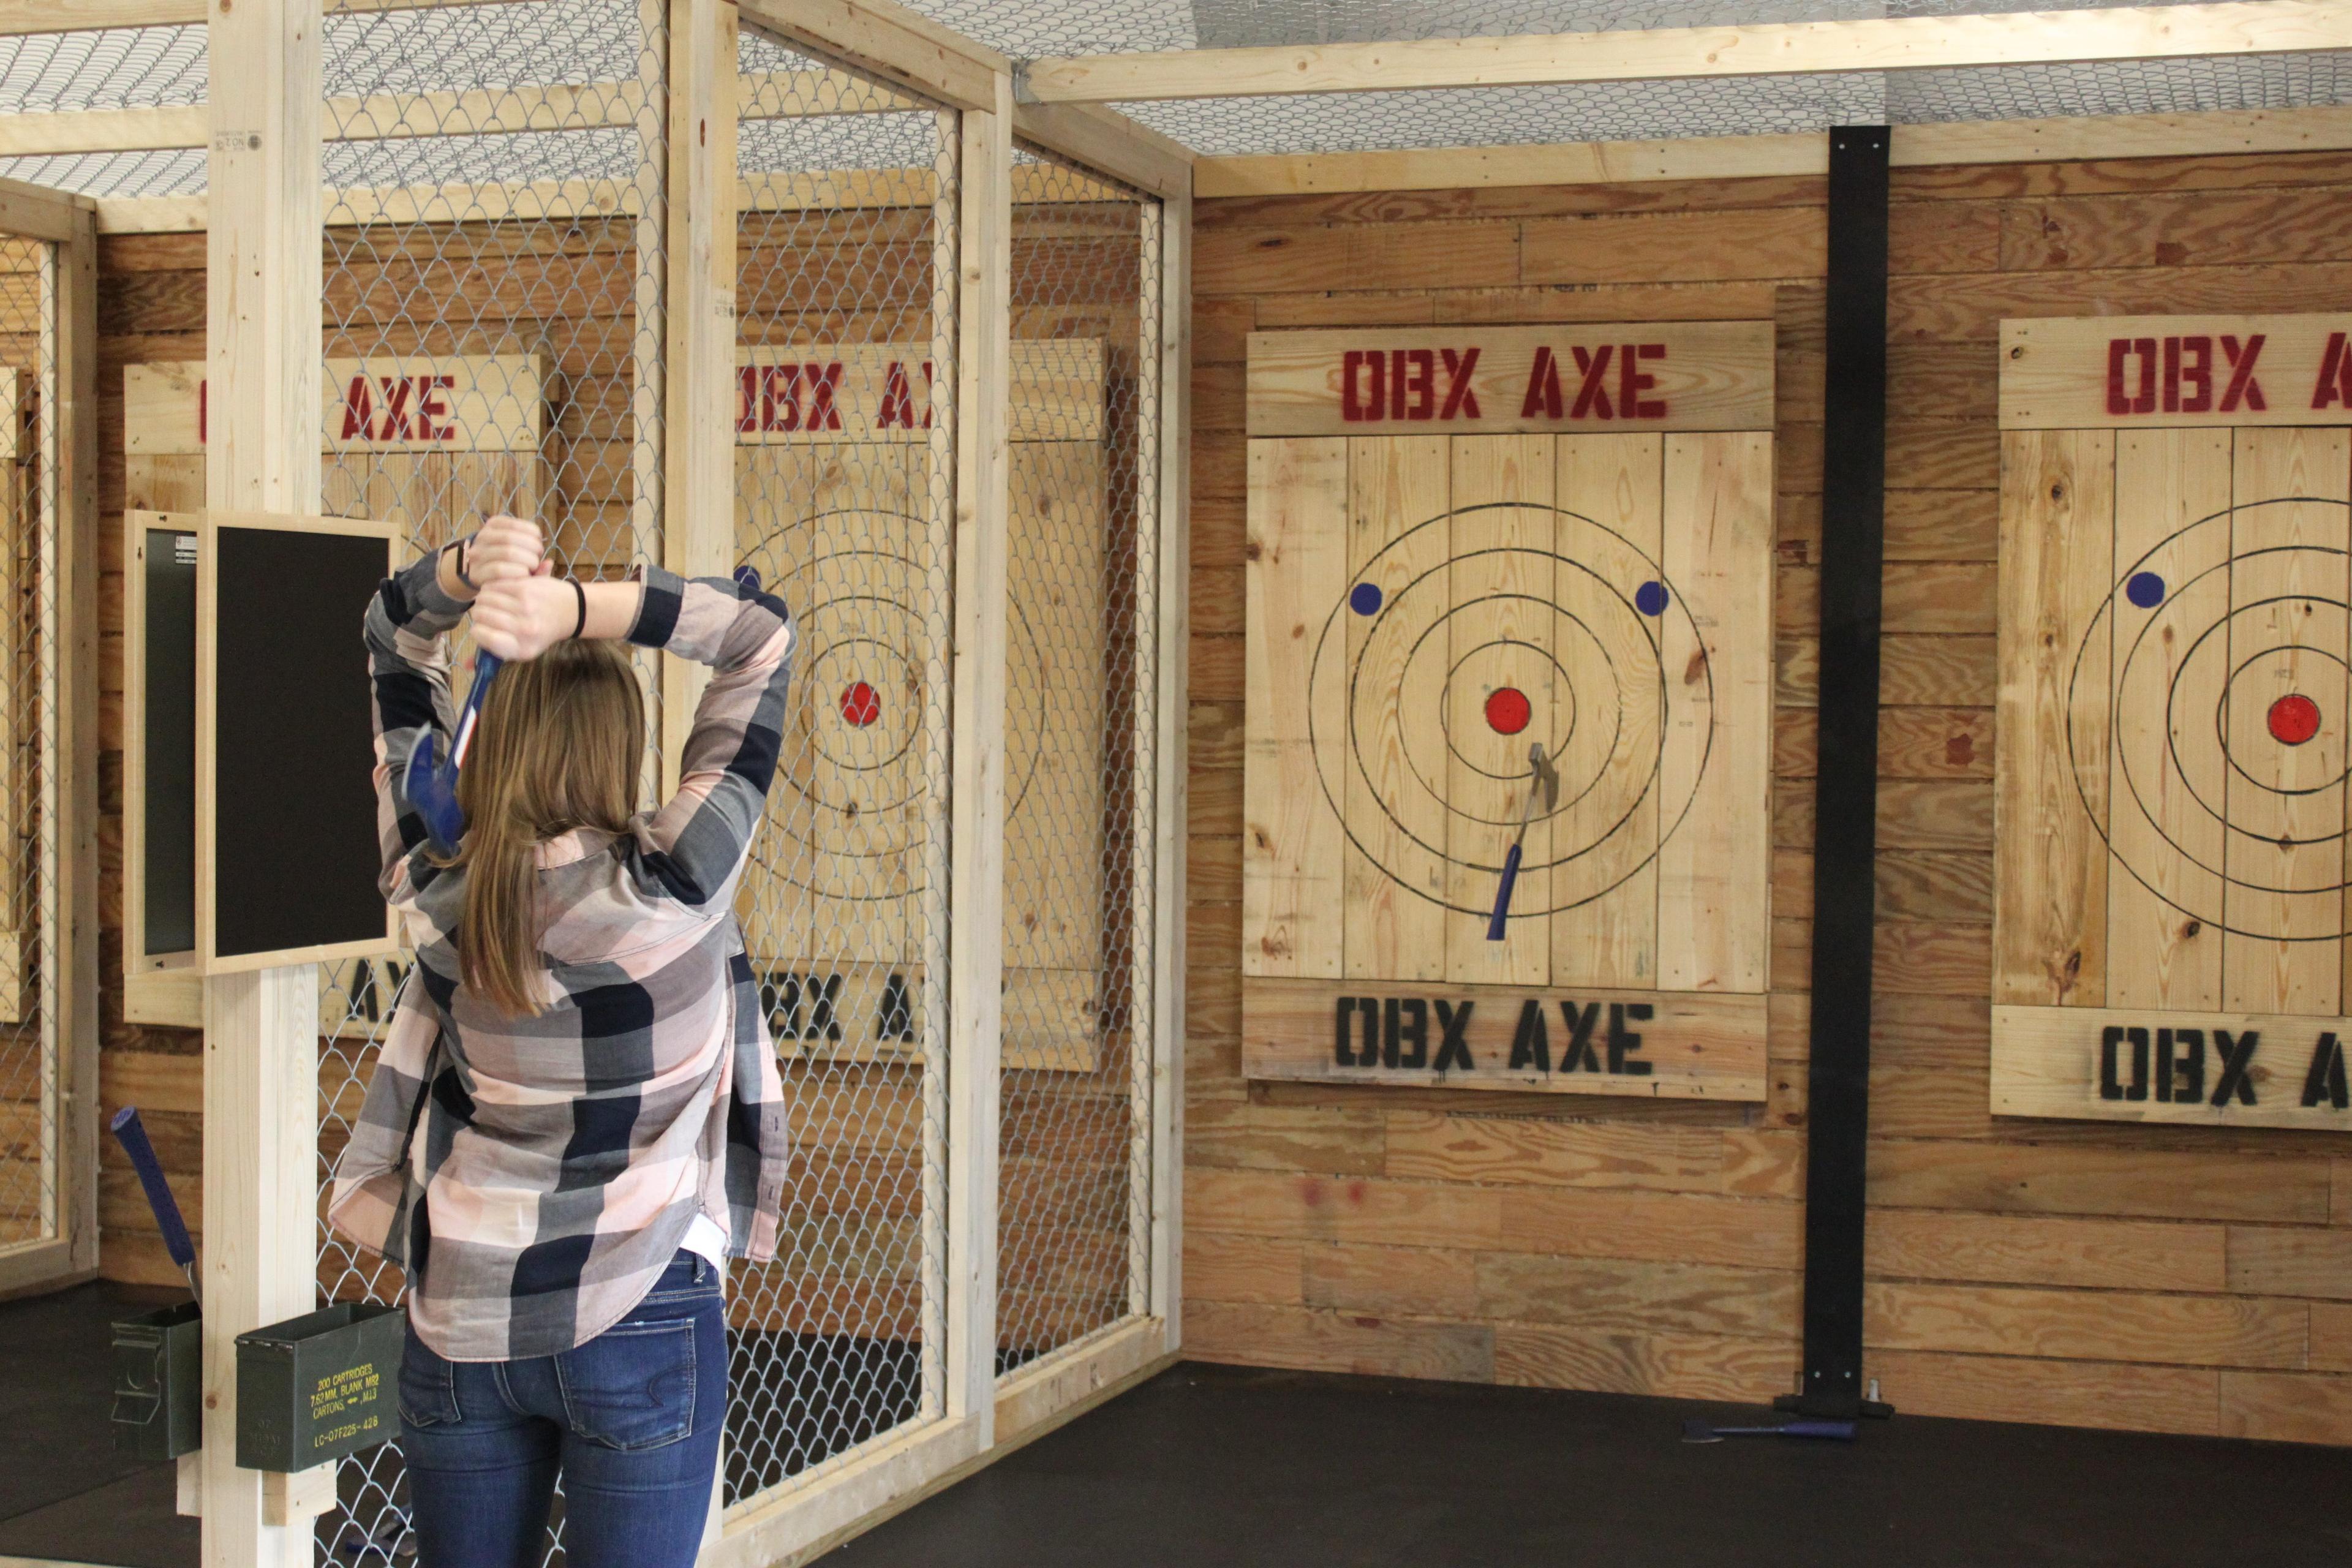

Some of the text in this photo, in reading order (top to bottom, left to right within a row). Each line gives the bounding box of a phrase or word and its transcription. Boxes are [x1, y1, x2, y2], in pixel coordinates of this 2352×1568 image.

[341, 375, 454, 441] AXE
[1343, 344, 1666, 421] OBX AXE
[2106, 334, 2266, 415] OBX
[1335, 997, 1653, 1076] OBX AXE
[2101, 1026, 2260, 1107] OBX
[318, 1363, 372, 1391] 200 CARTRIDGES
[341, 1379, 363, 1396] BLANK
[365, 1373, 379, 1389] M82
